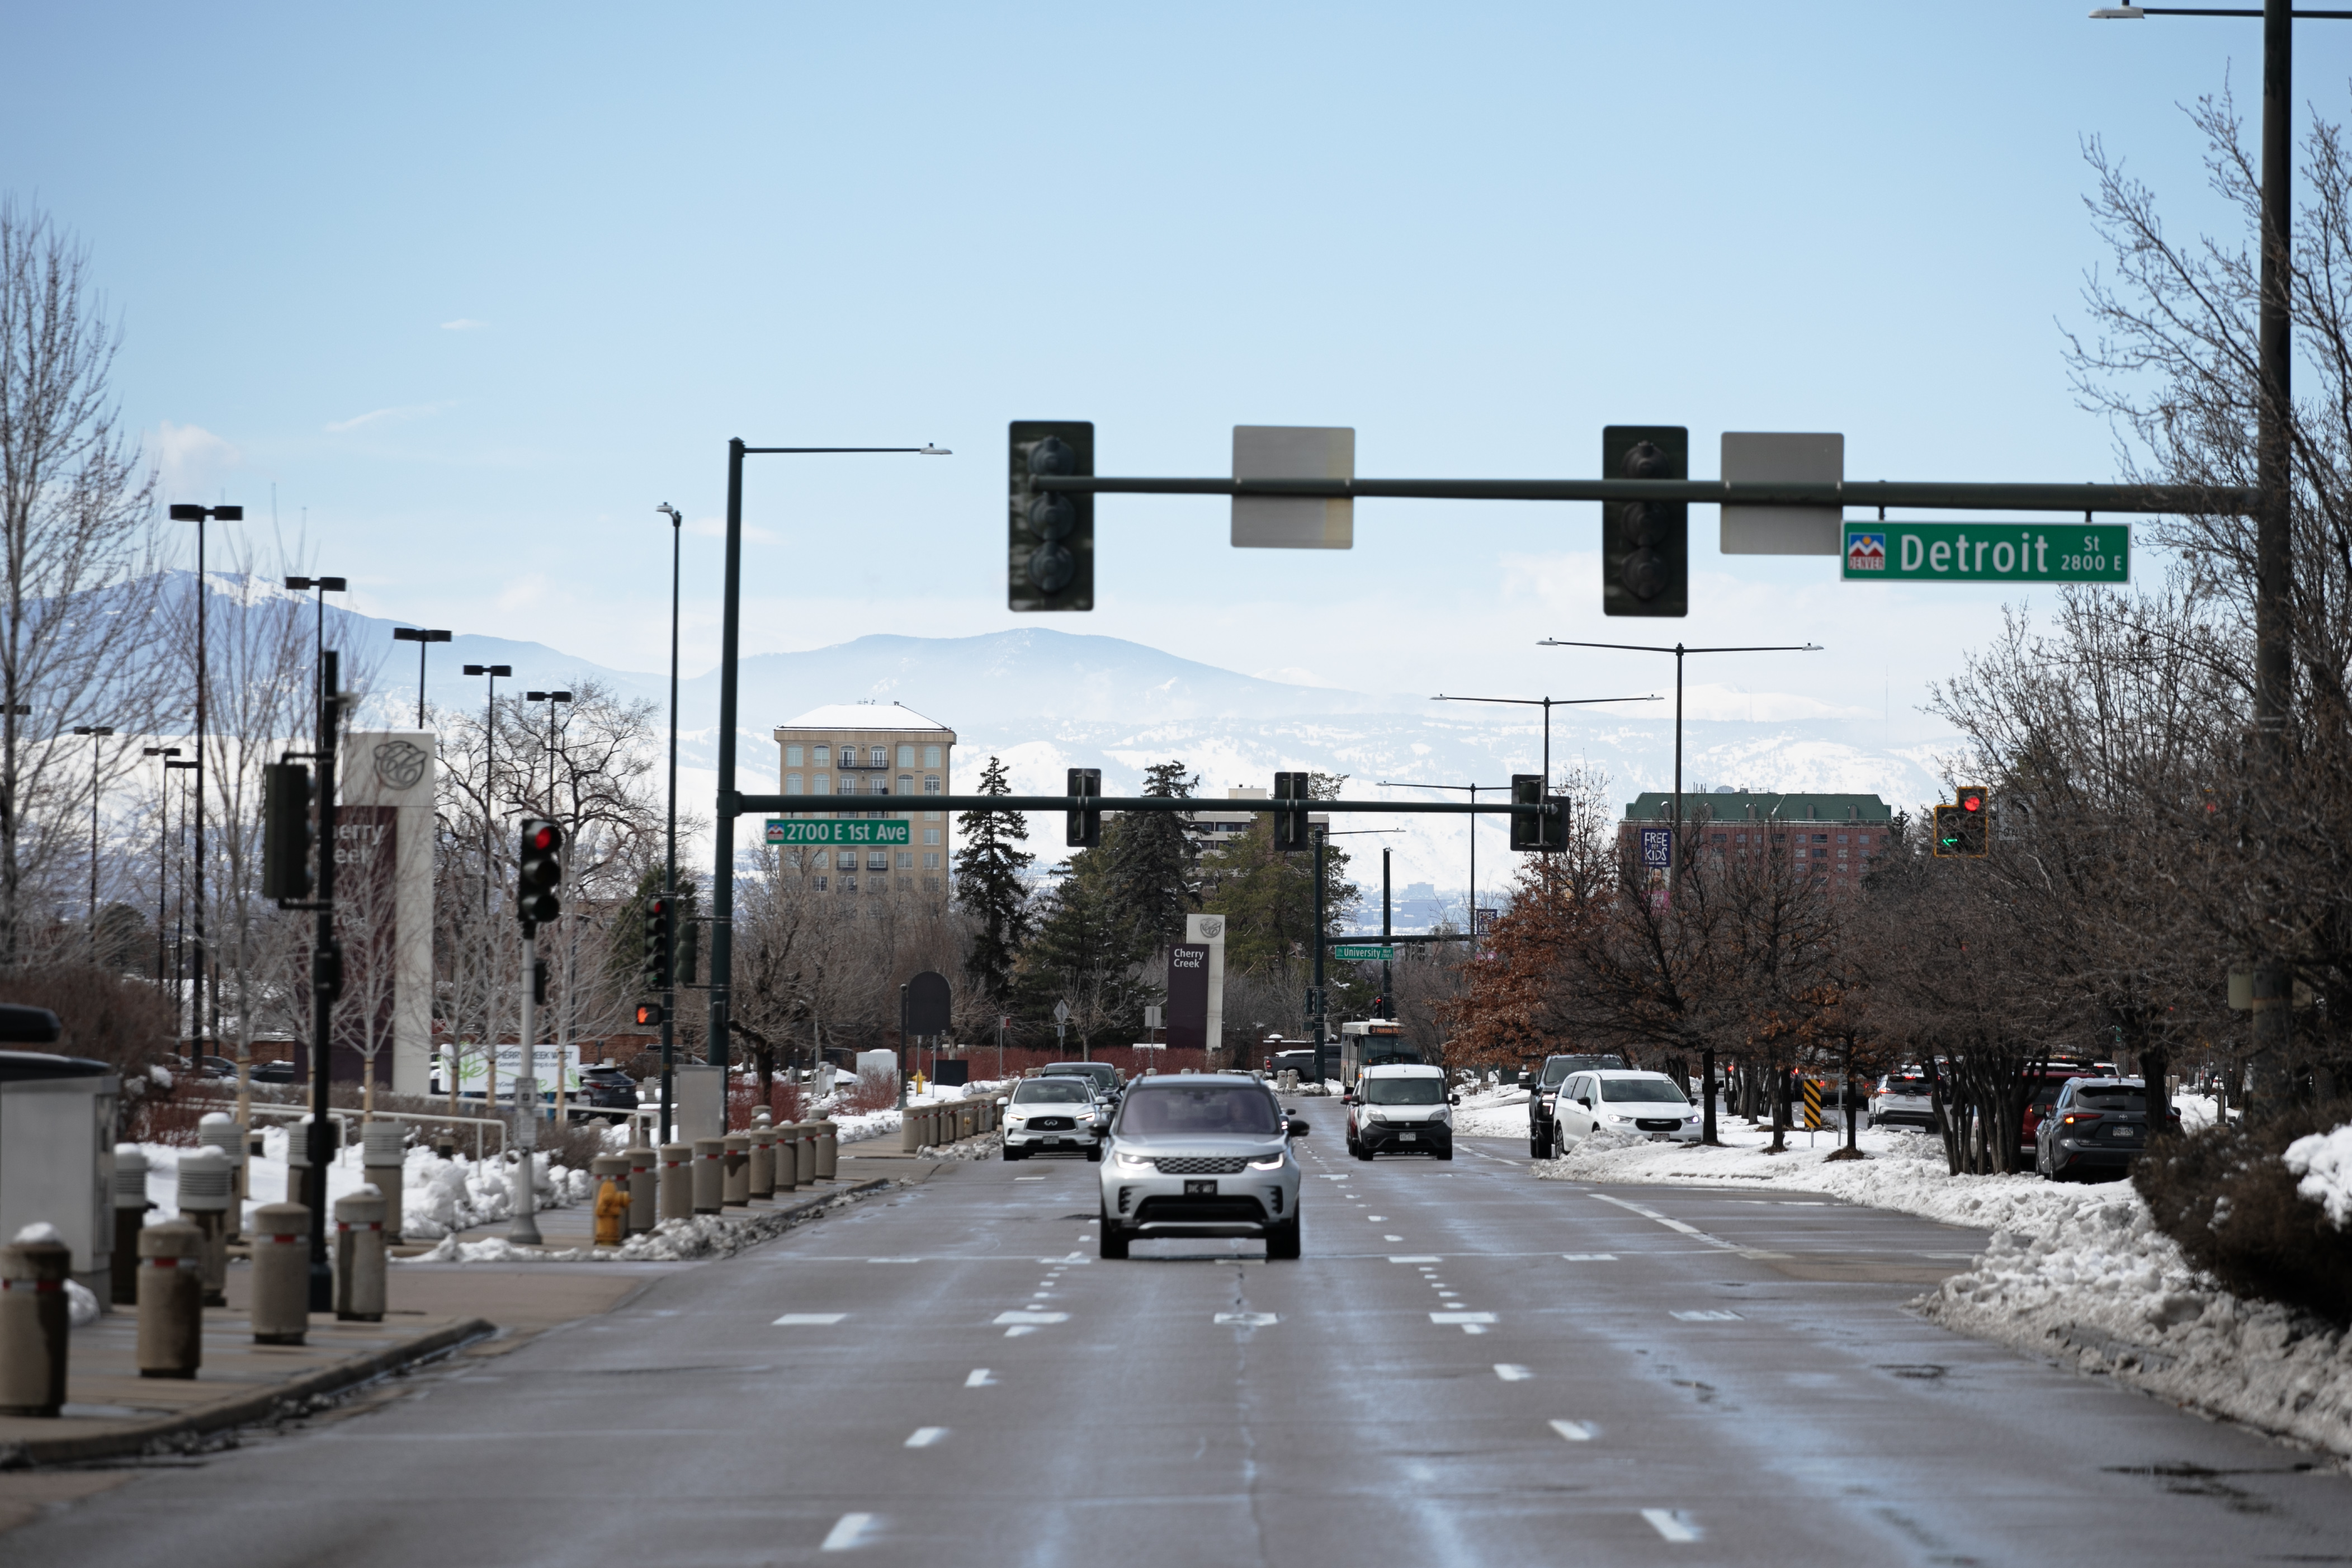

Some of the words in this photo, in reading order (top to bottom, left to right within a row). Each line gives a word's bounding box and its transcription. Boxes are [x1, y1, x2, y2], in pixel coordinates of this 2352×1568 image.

[1901, 532, 2048, 573] Detroit
[2084, 535, 2099, 552] St
[1849, 556, 1884, 569] DENVER
[2061, 555, 2105, 571] 2800
[2114, 555, 2121, 571] E
[786, 823, 829, 840] 2700
[834, 824, 843, 840] E
[848, 823, 870, 840] 1st
[876, 824, 906, 840] Ave
[1645, 832, 1668, 847] FREE
[1645, 847, 1668, 861] KIDS
[1174, 948, 1204, 960] Cherry
[1344, 948, 1381, 959] University
[1174, 958, 1200, 968] Creek
